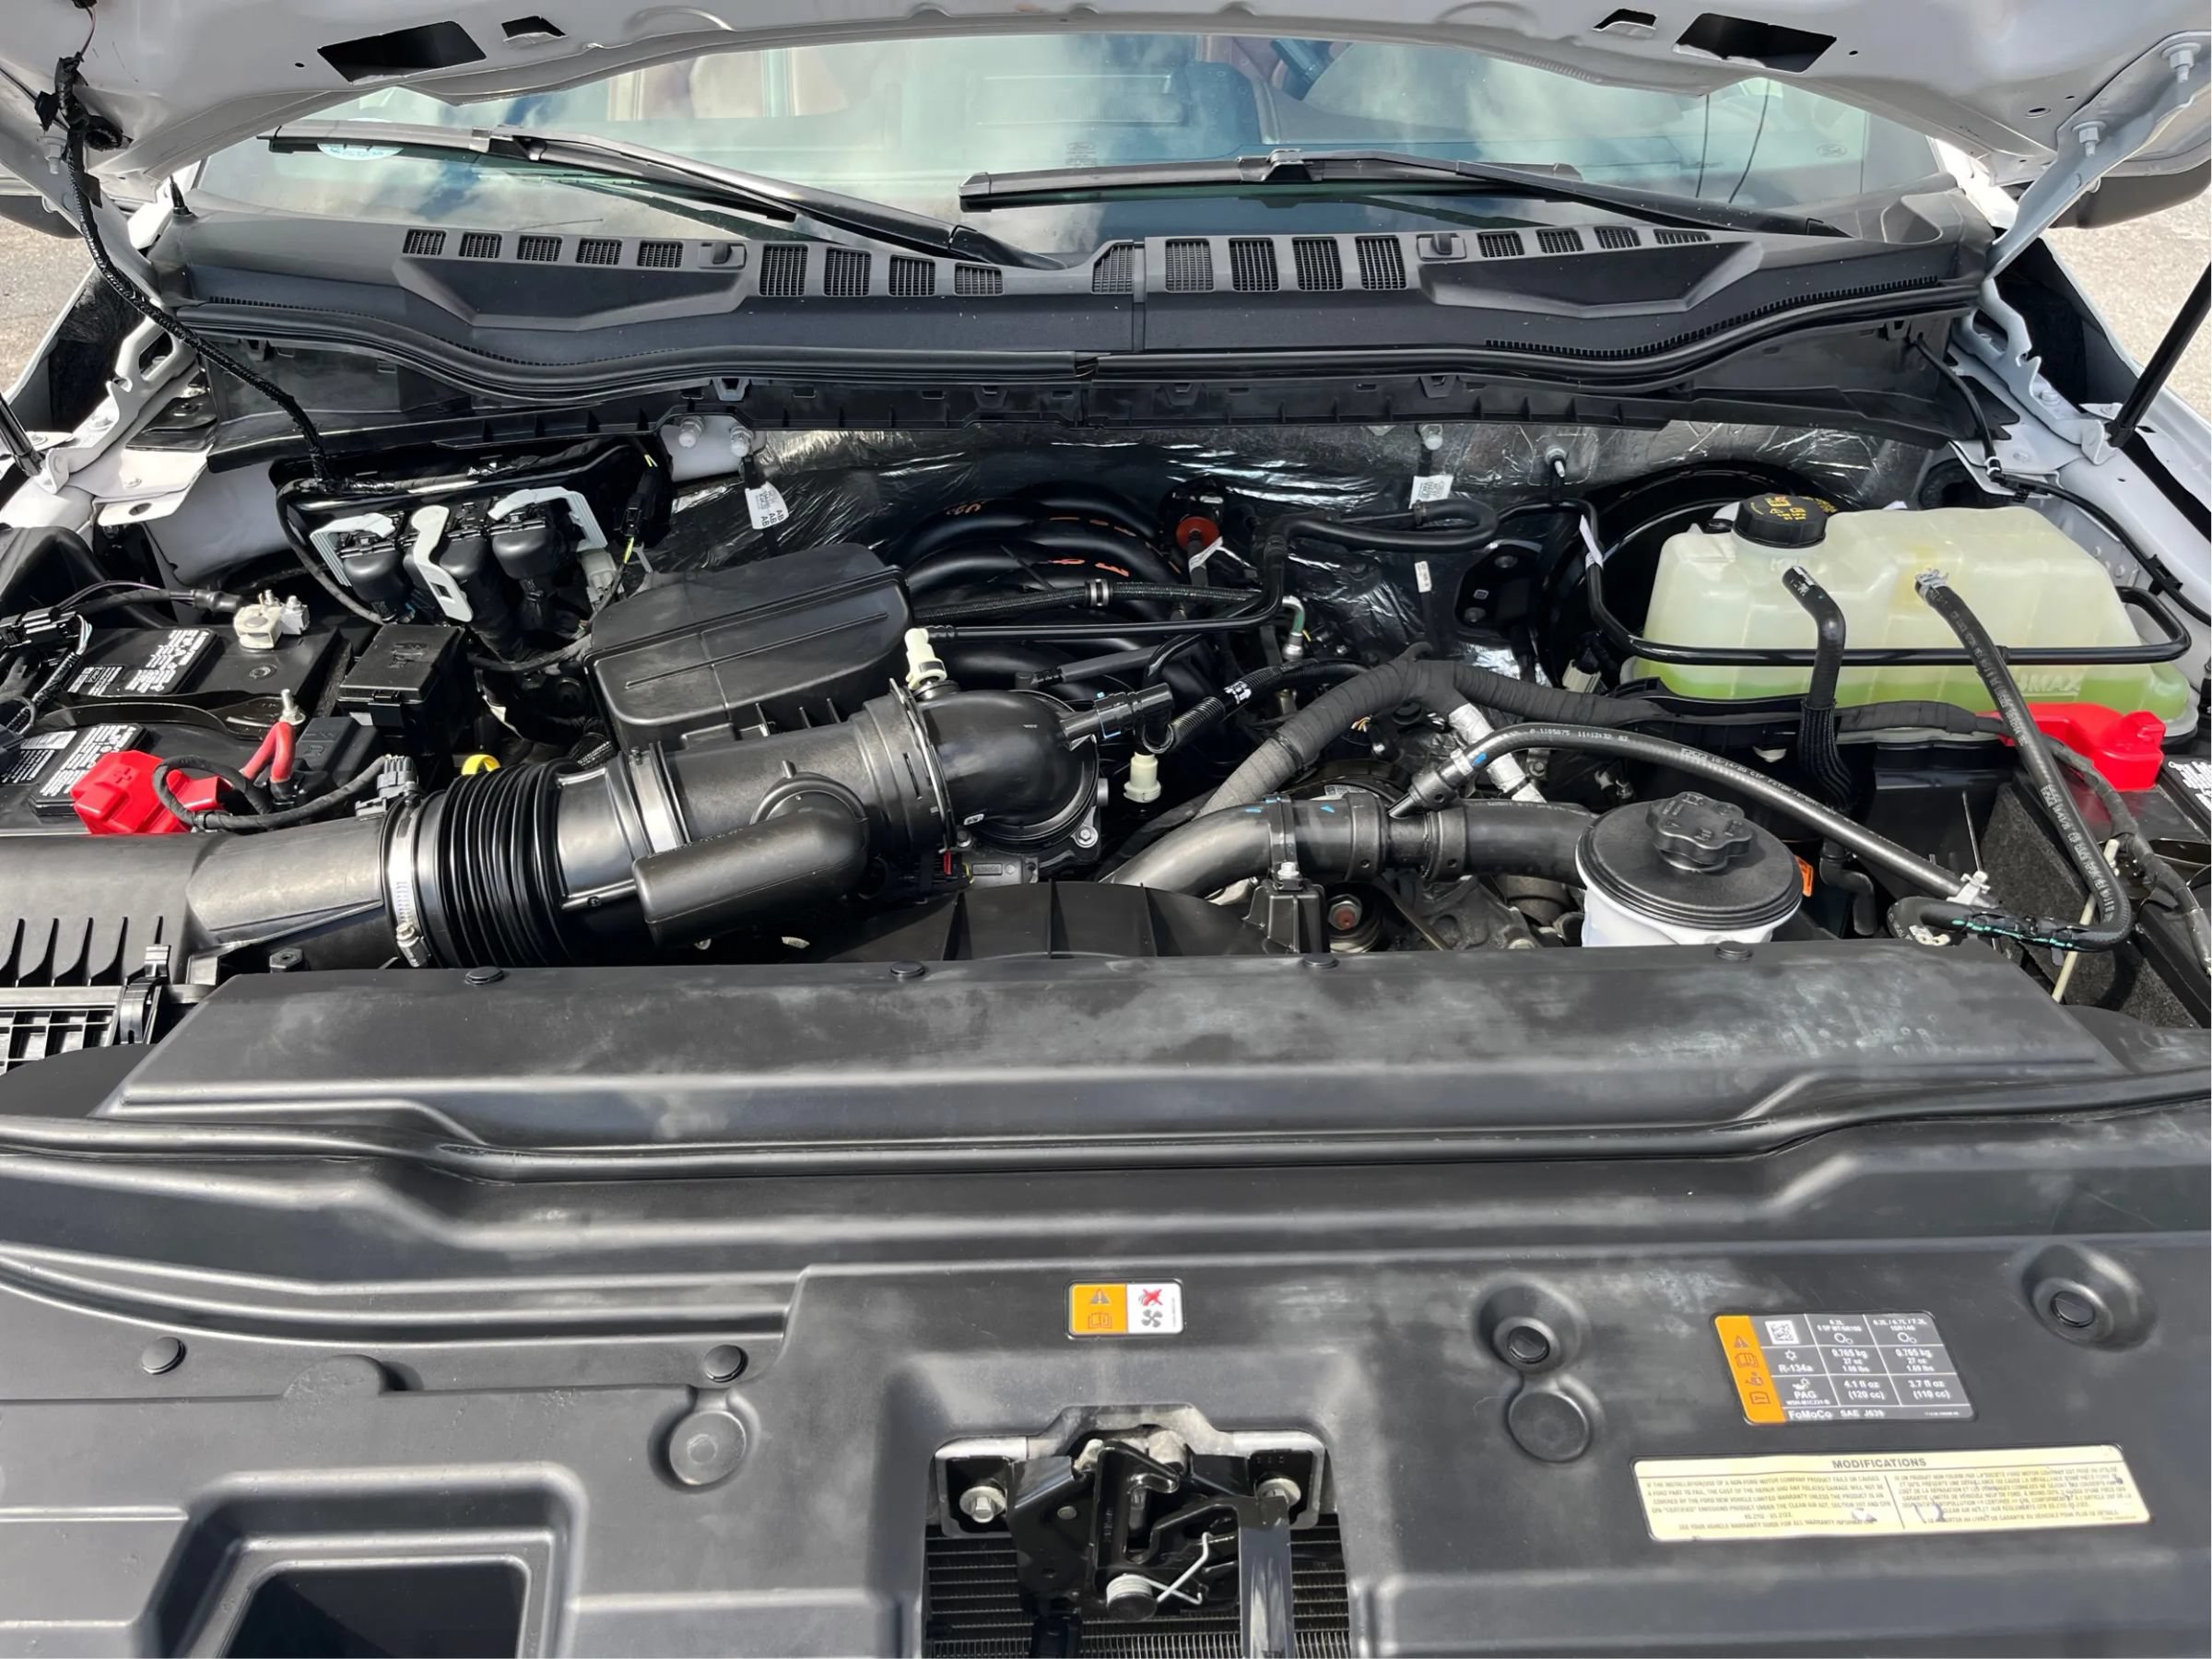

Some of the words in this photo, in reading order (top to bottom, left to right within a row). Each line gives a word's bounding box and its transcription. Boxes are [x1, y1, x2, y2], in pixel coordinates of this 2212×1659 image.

[1831, 1348, 1854, 1358] 0.765
[1854, 1348, 1868, 1359] kg
[1895, 1348, 1918, 1358] 0.765
[1919, 1348, 1933, 1359] kg
[1778, 1364, 1814, 1373] R-134a
[1843, 1380, 1857, 1389] 4.1
[1858, 1380, 1867, 1388] fl
[1907, 1379, 1923, 1388] 3.7
[1924, 1379, 1932, 1388] fl
[1793, 1390, 1818, 1400] PAG
[1848, 1390, 1868, 1400] (120
[1869, 1390, 1886, 1400] cc)
[1912, 1390, 1934, 1400] (110
[1935, 1390, 1951, 1400] cc)
[1788, 1409, 1833, 1419] FoMoCo
[1840, 1409, 1860, 1418] SAE
[1864, 1409, 1886, 1418] J639
[1831, 1458, 1927, 1469] MODIFICATIONS
